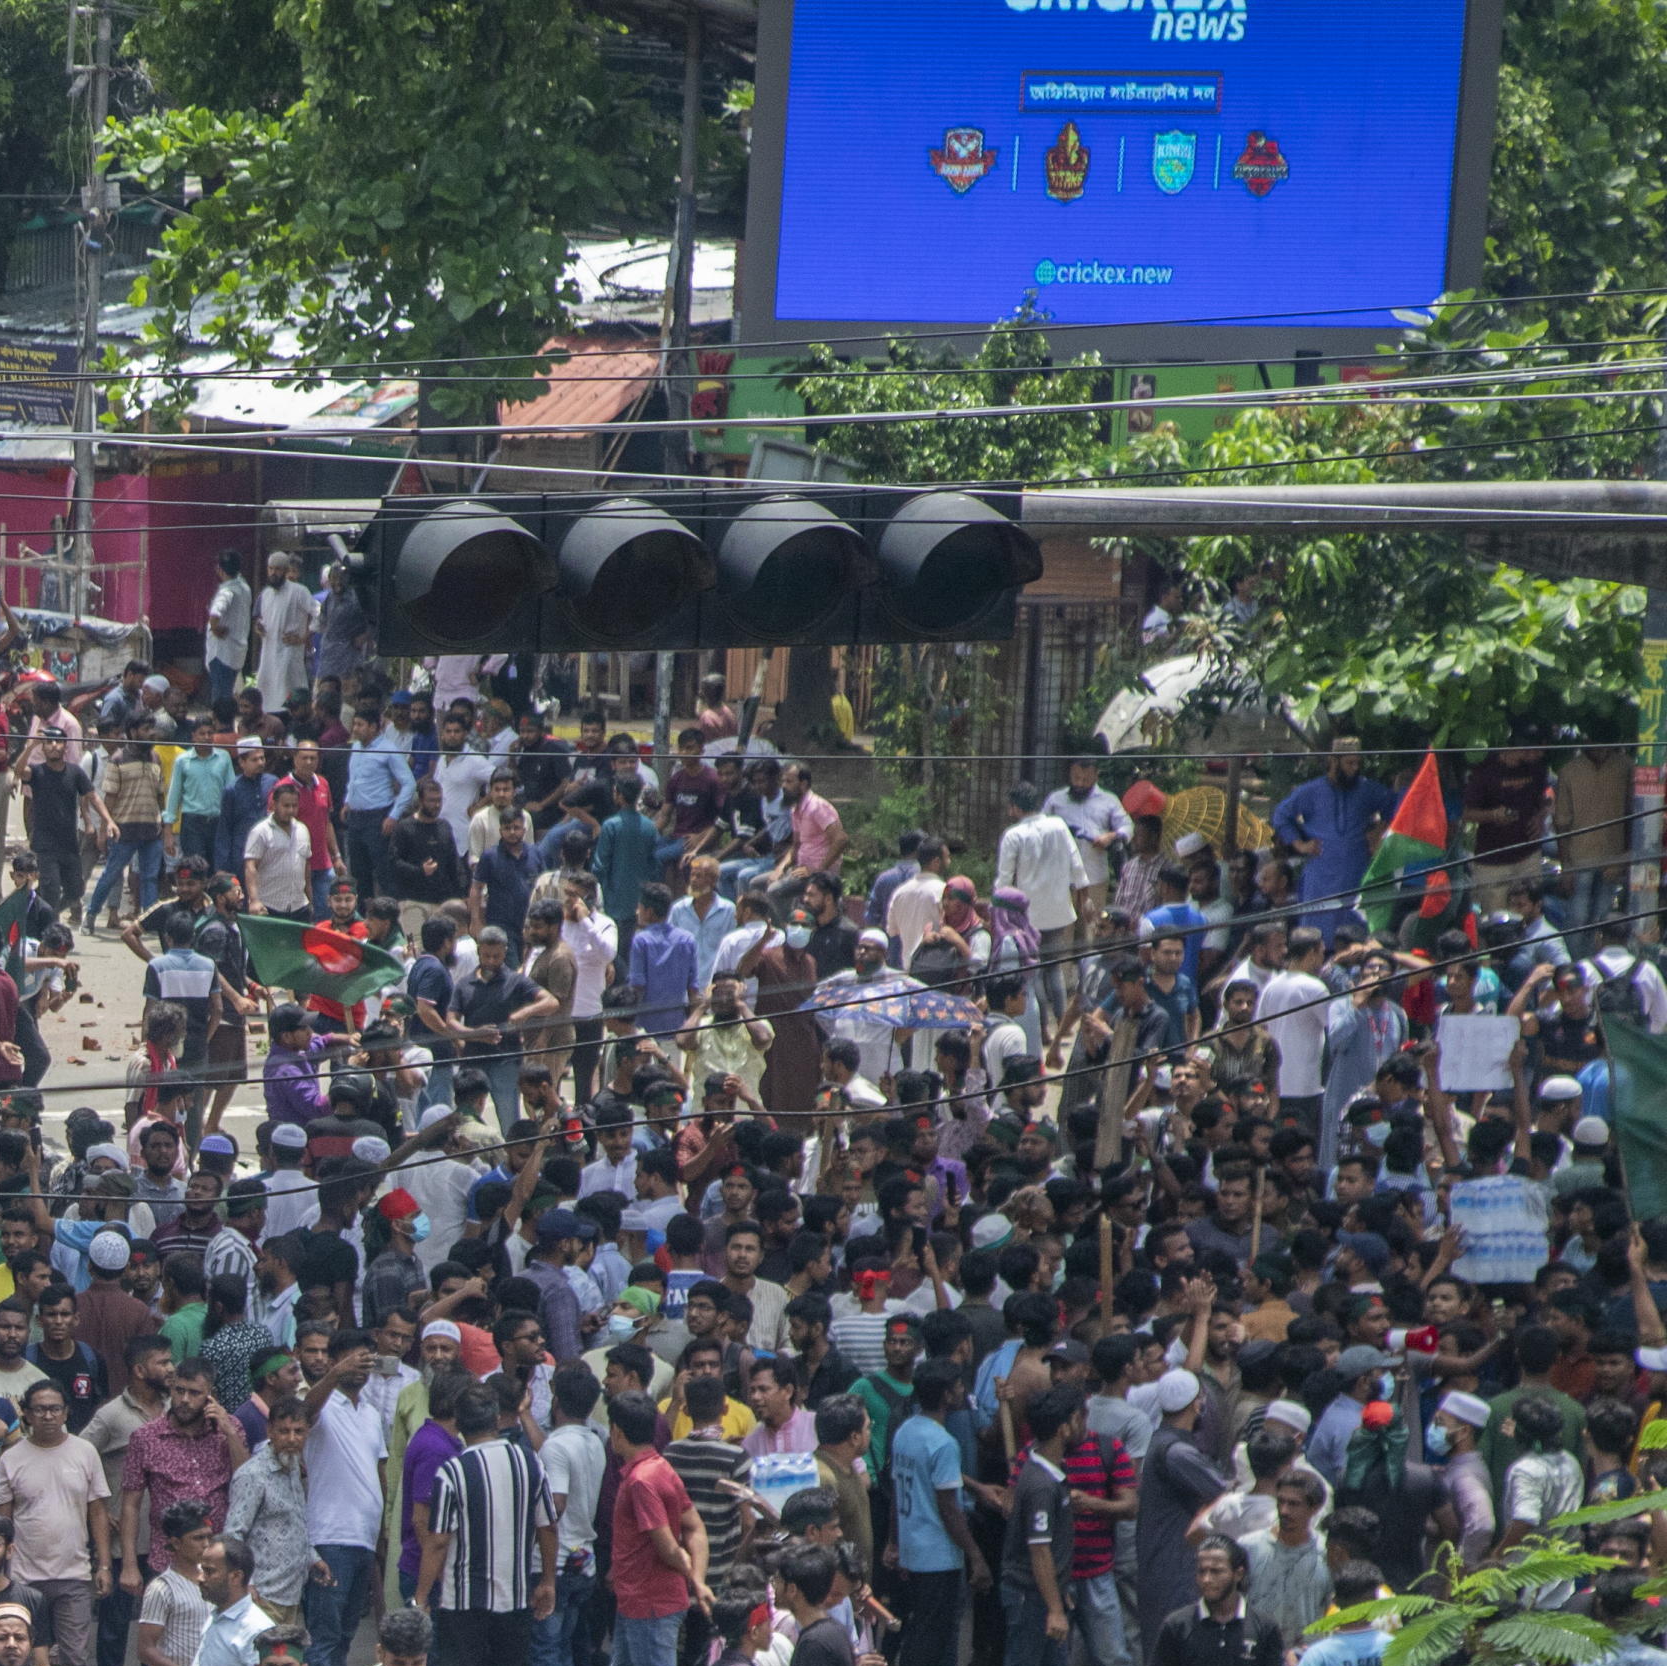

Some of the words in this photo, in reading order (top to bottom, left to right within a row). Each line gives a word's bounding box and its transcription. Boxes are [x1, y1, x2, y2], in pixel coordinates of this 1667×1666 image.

[1151, 11, 1247, 42] news
[1057, 261, 1173, 284] crickex.new
[1035, 1511, 1048, 1532] 3
